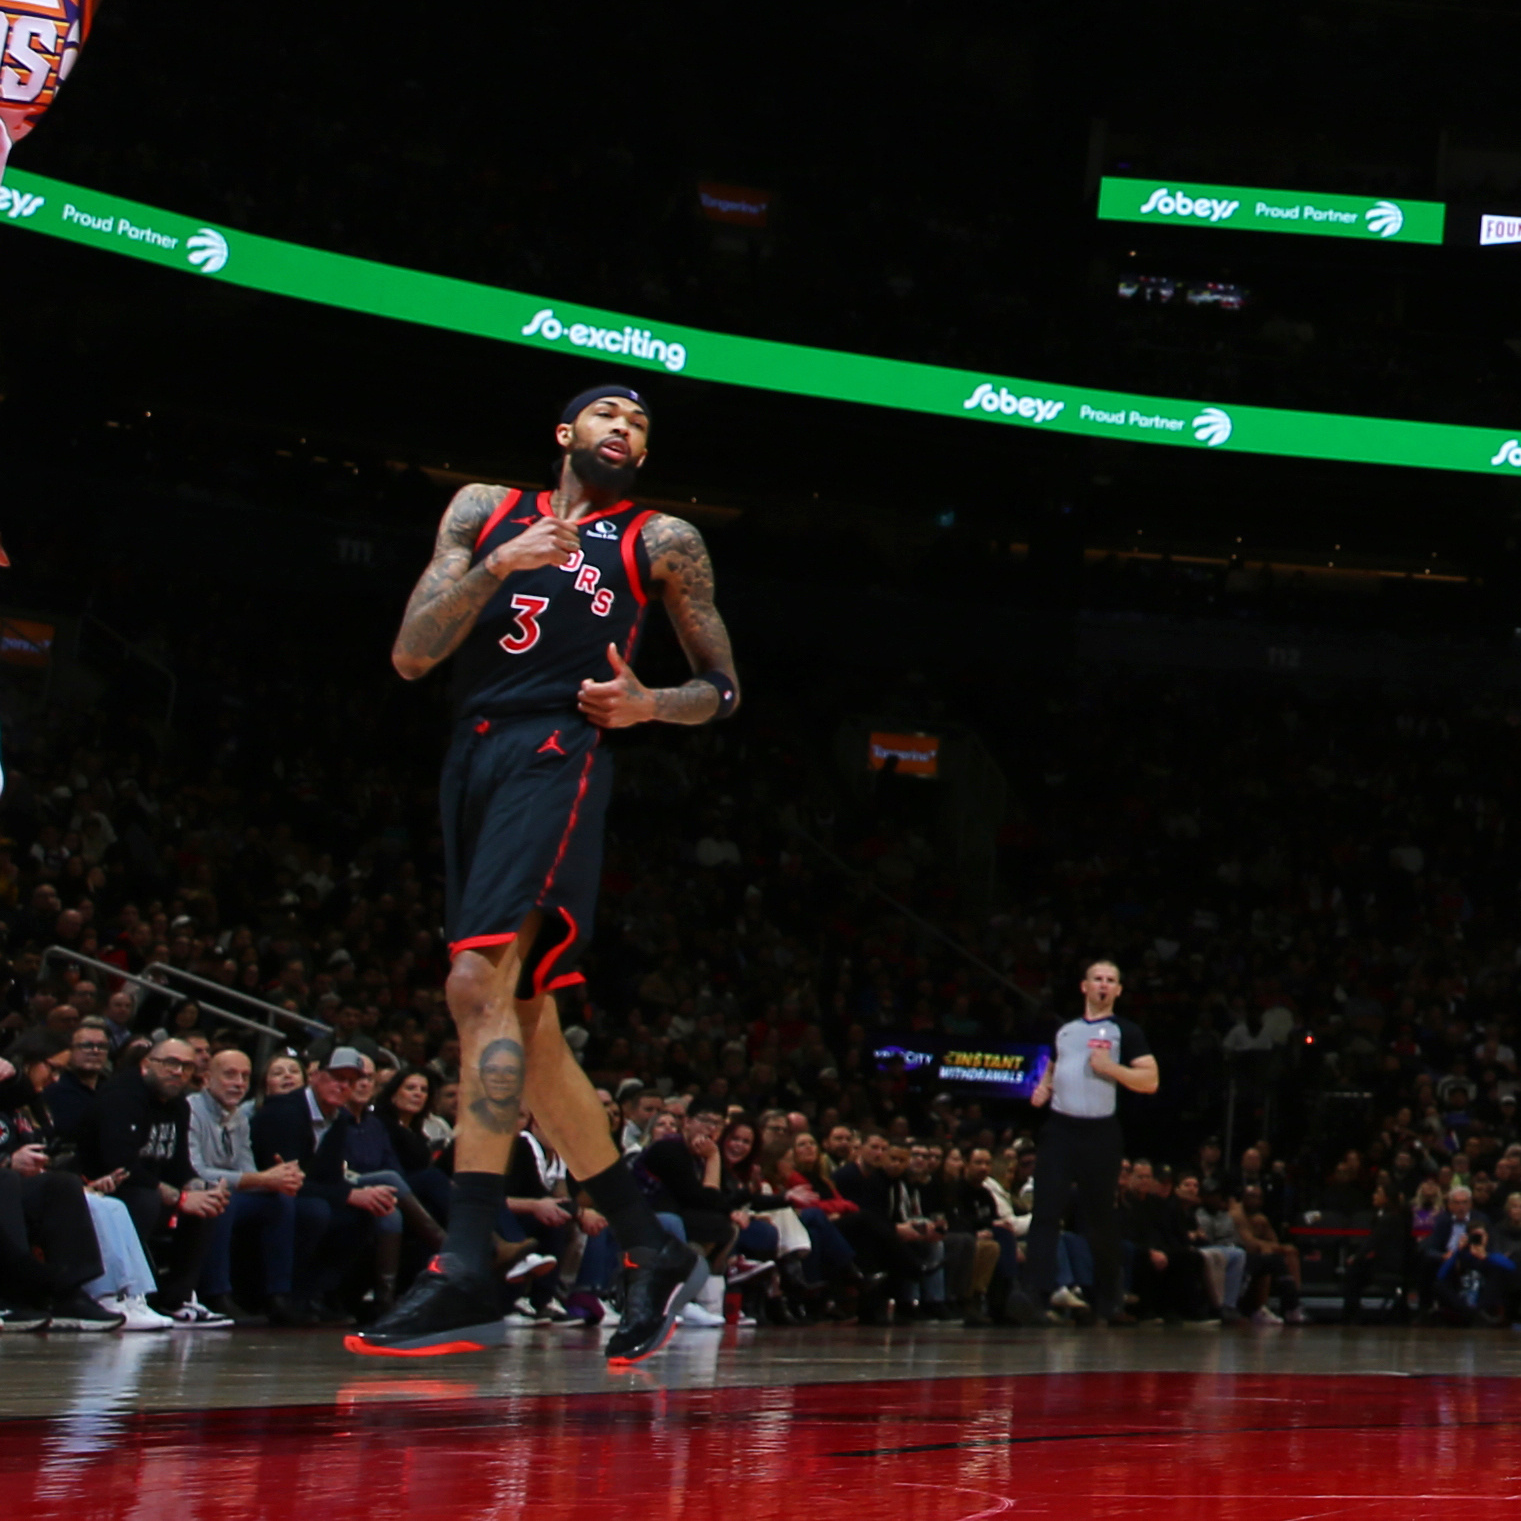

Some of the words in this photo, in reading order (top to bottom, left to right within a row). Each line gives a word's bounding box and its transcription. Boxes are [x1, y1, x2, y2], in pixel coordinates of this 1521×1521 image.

[62, 203, 114, 232] Proud
[117, 219, 179, 249] Partner
[1140, 188, 1240, 222] Sobeys
[1255, 202, 1300, 220] Proud
[1303, 206, 1358, 224] Partner
[963, 383, 1065, 423] Sobeys
[1080, 404, 1126, 425] Proud
[1129, 412, 1185, 431] Partner
[499, 593, 550, 655] 3
